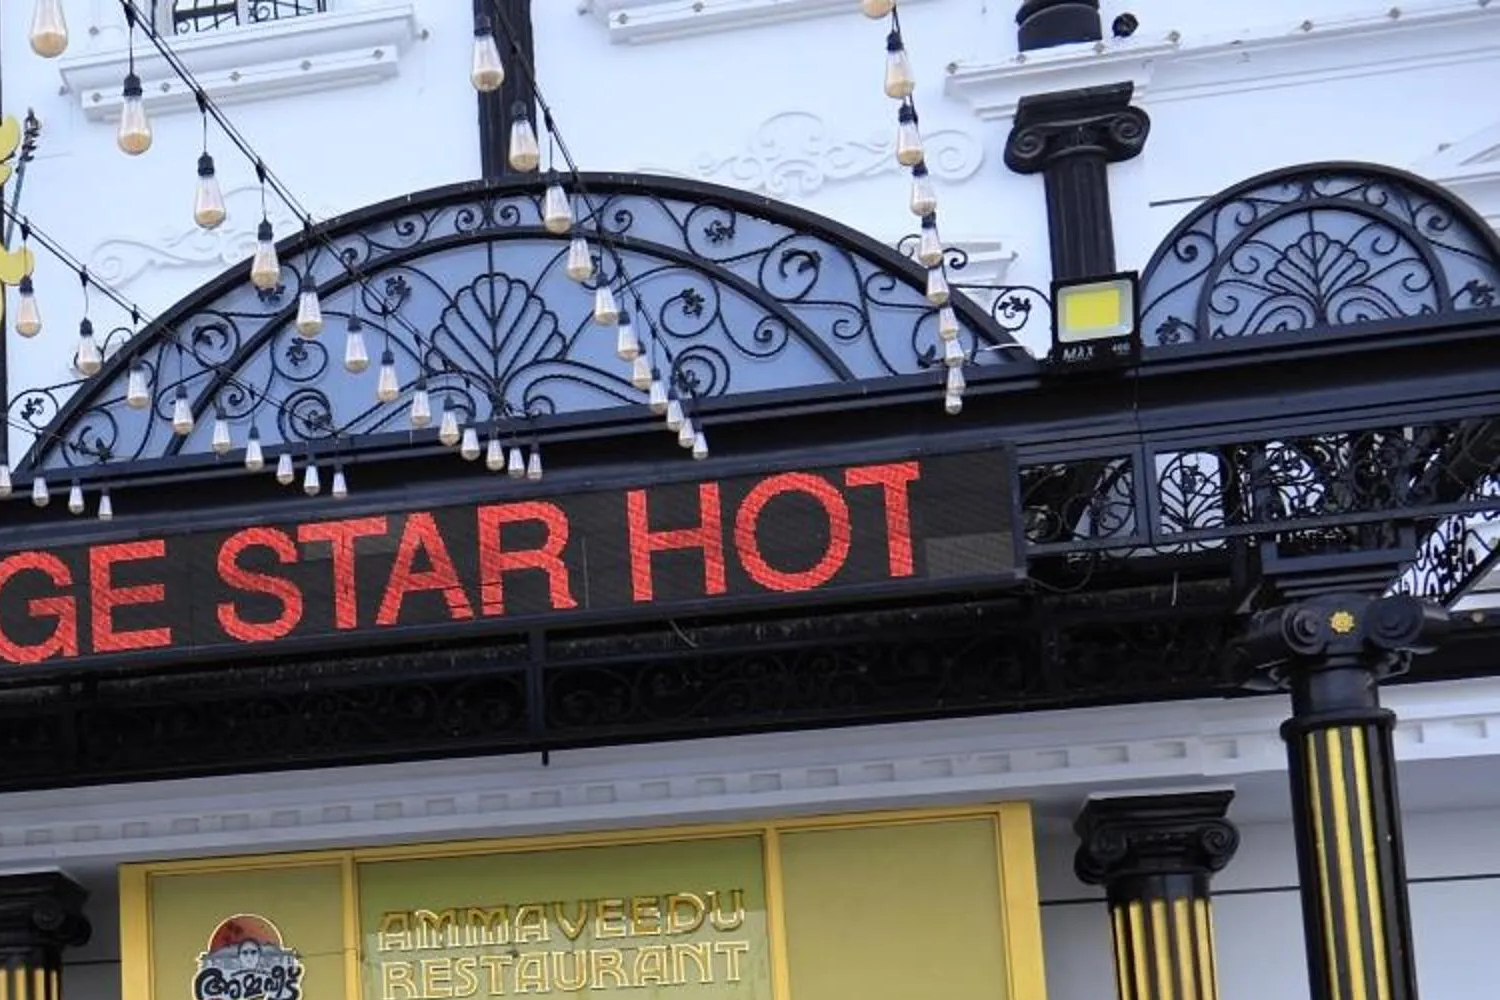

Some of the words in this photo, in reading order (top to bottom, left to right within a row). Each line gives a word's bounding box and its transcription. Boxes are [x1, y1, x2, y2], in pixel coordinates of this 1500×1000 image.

[216, 500, 578, 642] STAR
[626, 461, 921, 602] HOT
[377, 890, 745, 951] AMMAVEEDU
[380, 941, 750, 1000] RESTAURANT
